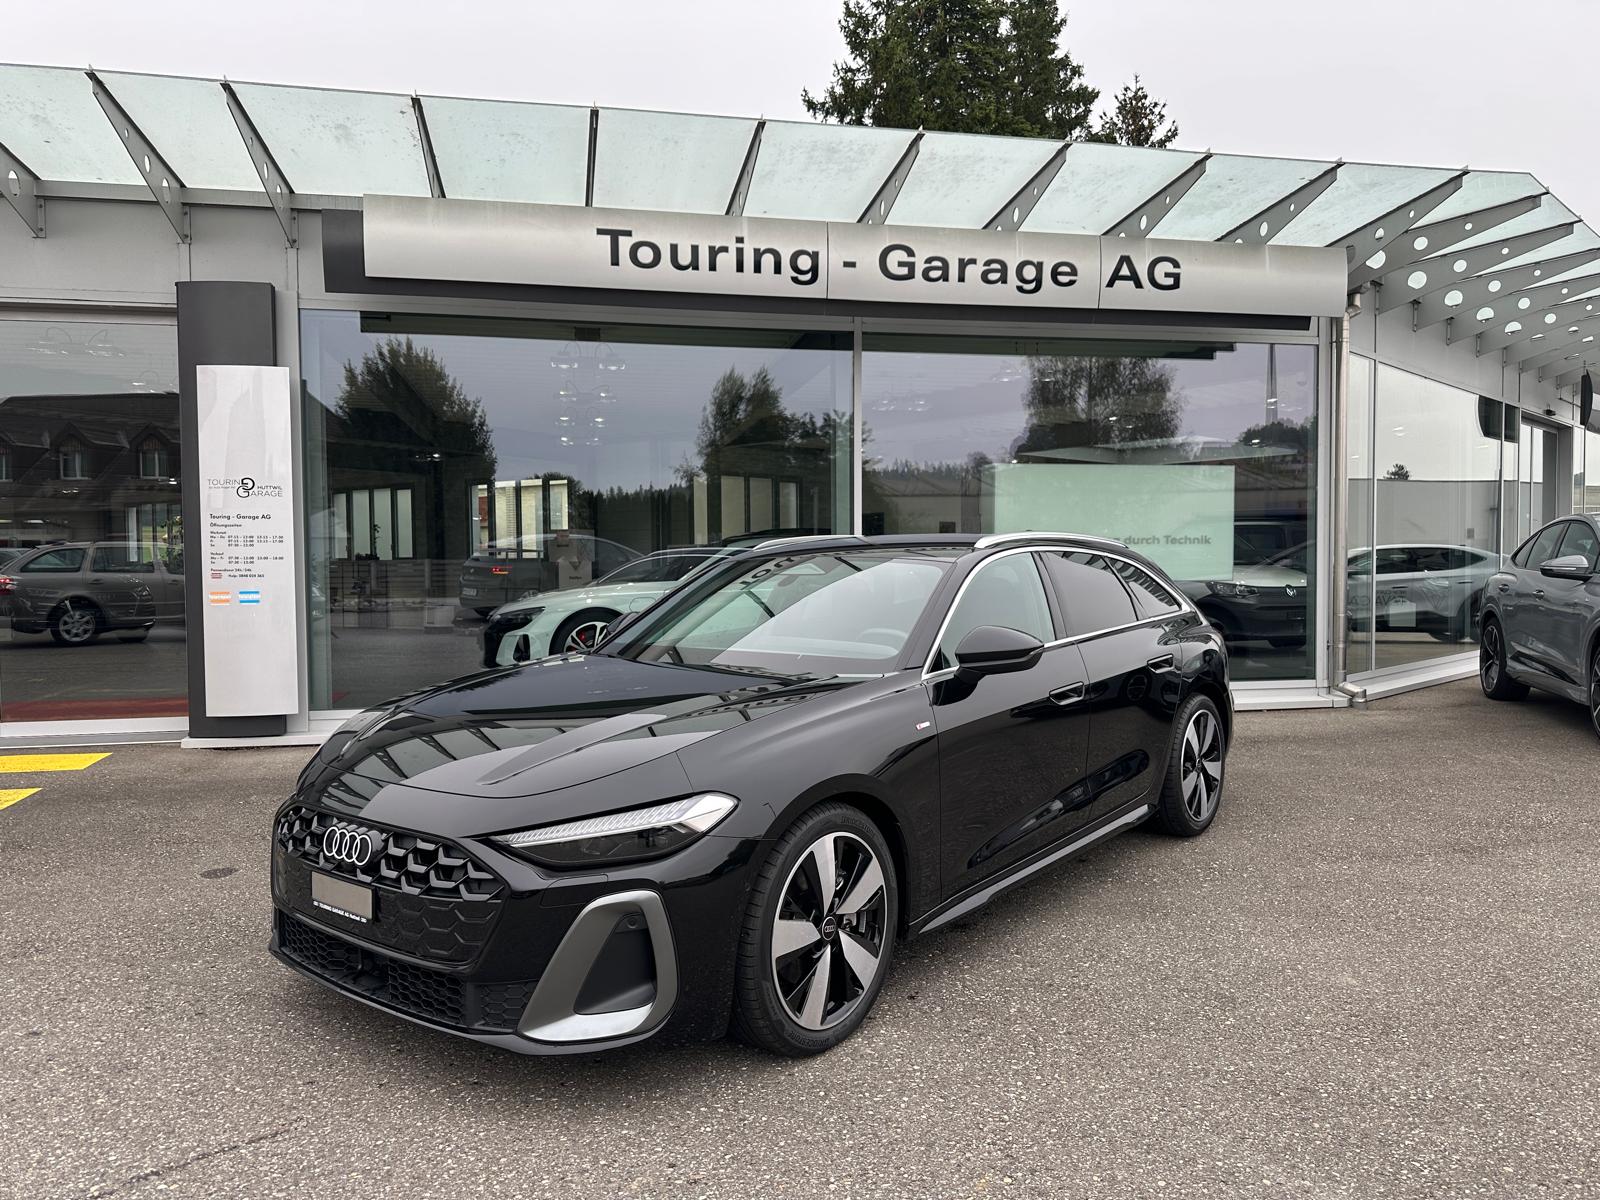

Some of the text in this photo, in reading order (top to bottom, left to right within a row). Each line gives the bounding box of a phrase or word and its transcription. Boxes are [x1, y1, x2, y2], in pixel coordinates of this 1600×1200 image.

[596, 227, 1181, 295] Touring - Garage AG
[1124, 535, 1160, 545] durch
[1164, 535, 1211, 545] Technik
